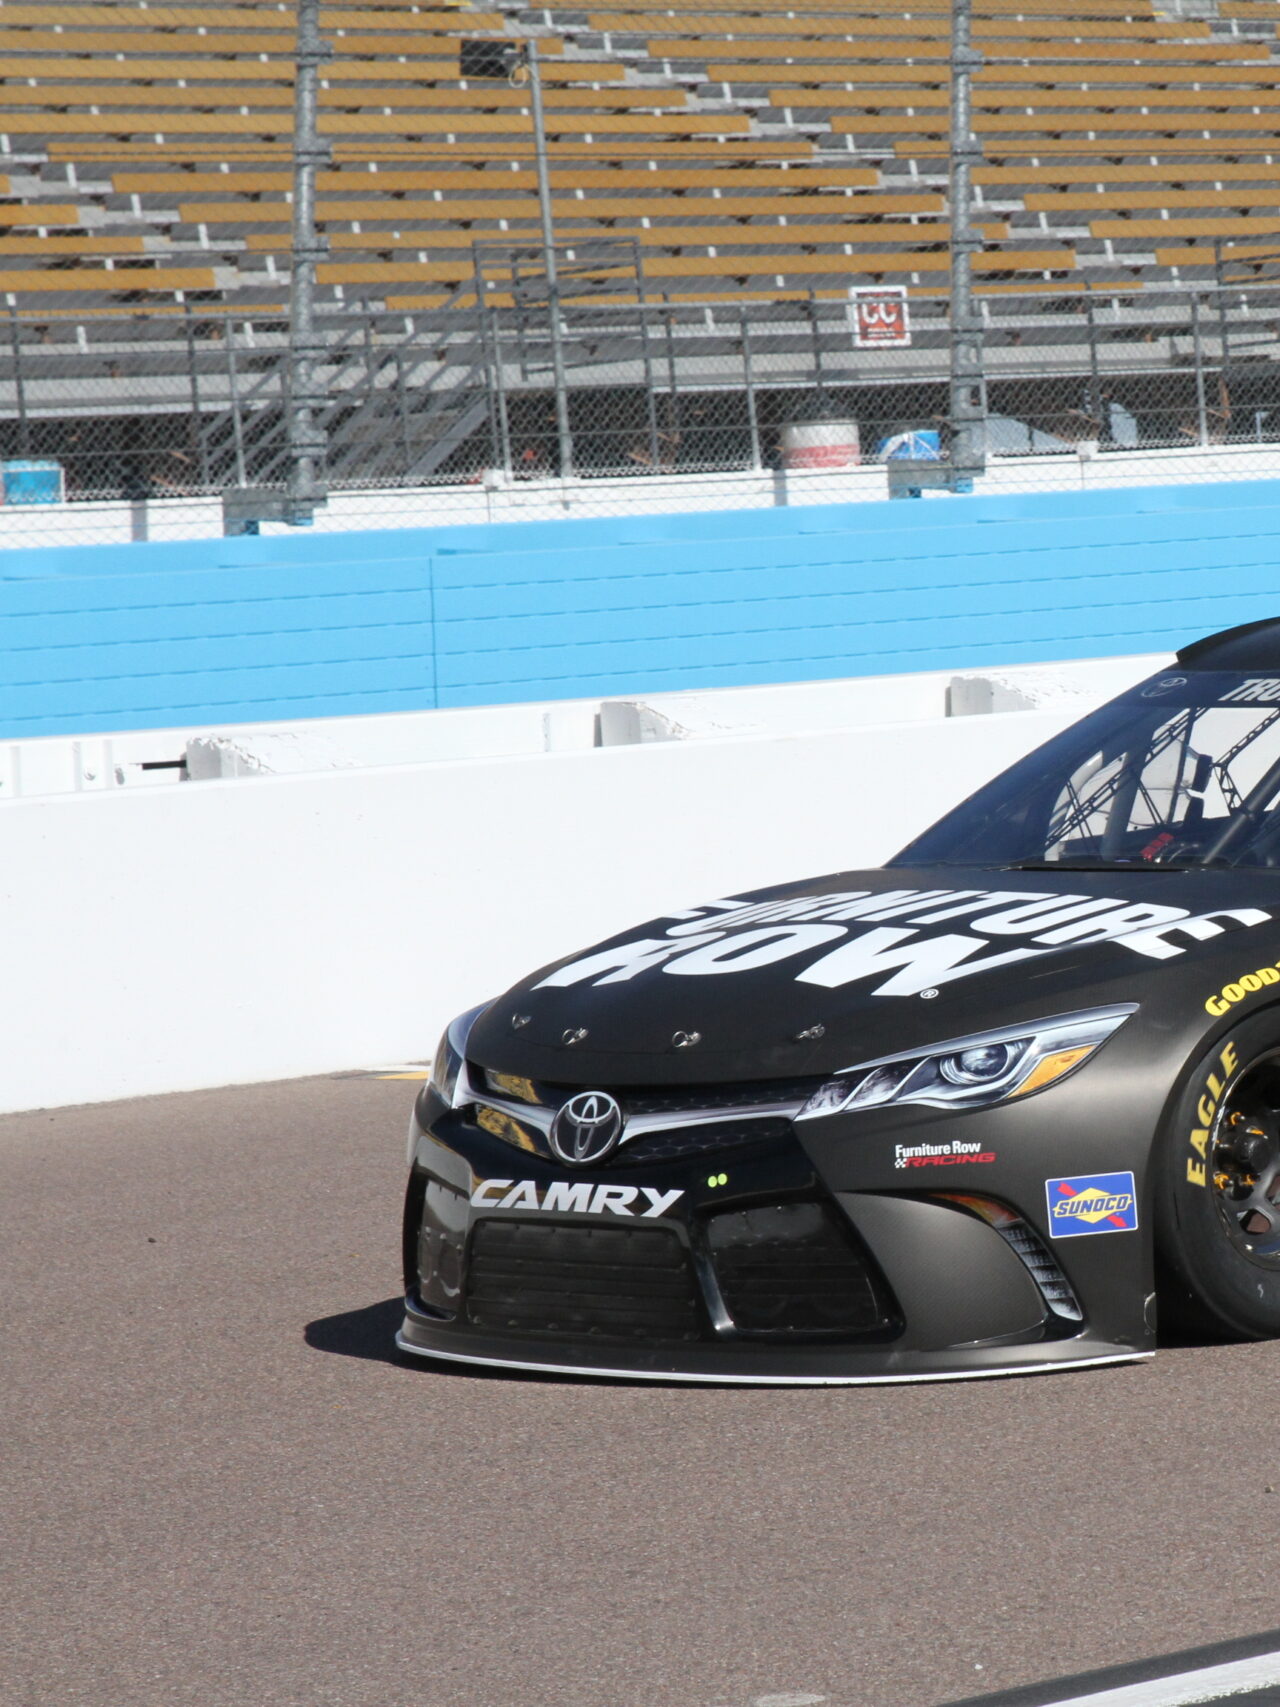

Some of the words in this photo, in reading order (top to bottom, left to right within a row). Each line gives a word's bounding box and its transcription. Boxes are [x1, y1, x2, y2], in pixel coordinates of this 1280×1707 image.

[861, 296, 897, 324] CC
[529, 923, 1064, 997] ROW
[1187, 1041, 1239, 1187] EAGLE
[895, 1142, 951, 1158] Furniture
[952, 1140, 981, 1154] Row
[905, 1152, 997, 1168] RACING
[470, 1178, 685, 1218] CAMRY
[1056, 1195, 1131, 1217] SUNOCO
